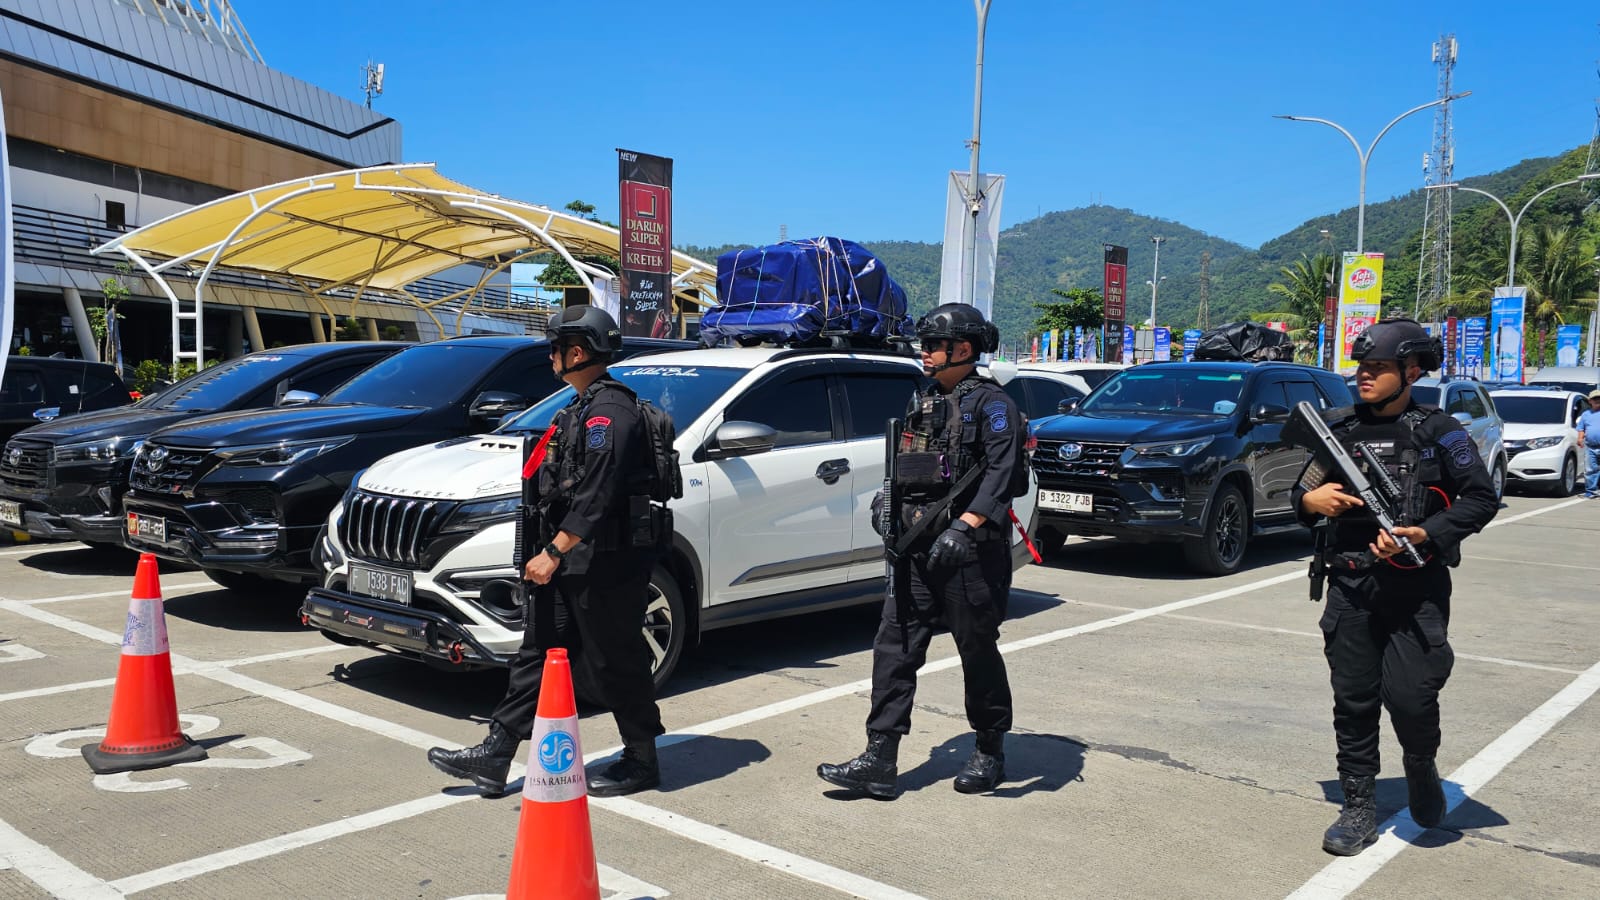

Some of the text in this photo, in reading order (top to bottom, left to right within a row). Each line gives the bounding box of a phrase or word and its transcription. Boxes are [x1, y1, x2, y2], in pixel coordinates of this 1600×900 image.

[620, 152, 638, 162] NEW
[626, 219, 664, 233] DJARUM
[630, 231, 661, 246] SUPER
[626, 252, 664, 267] KRETEK
[1040, 491, 1046, 502] B
[1075, 495, 1090, 505] FJB
[352, 566, 407, 595] F 1538 FAC
